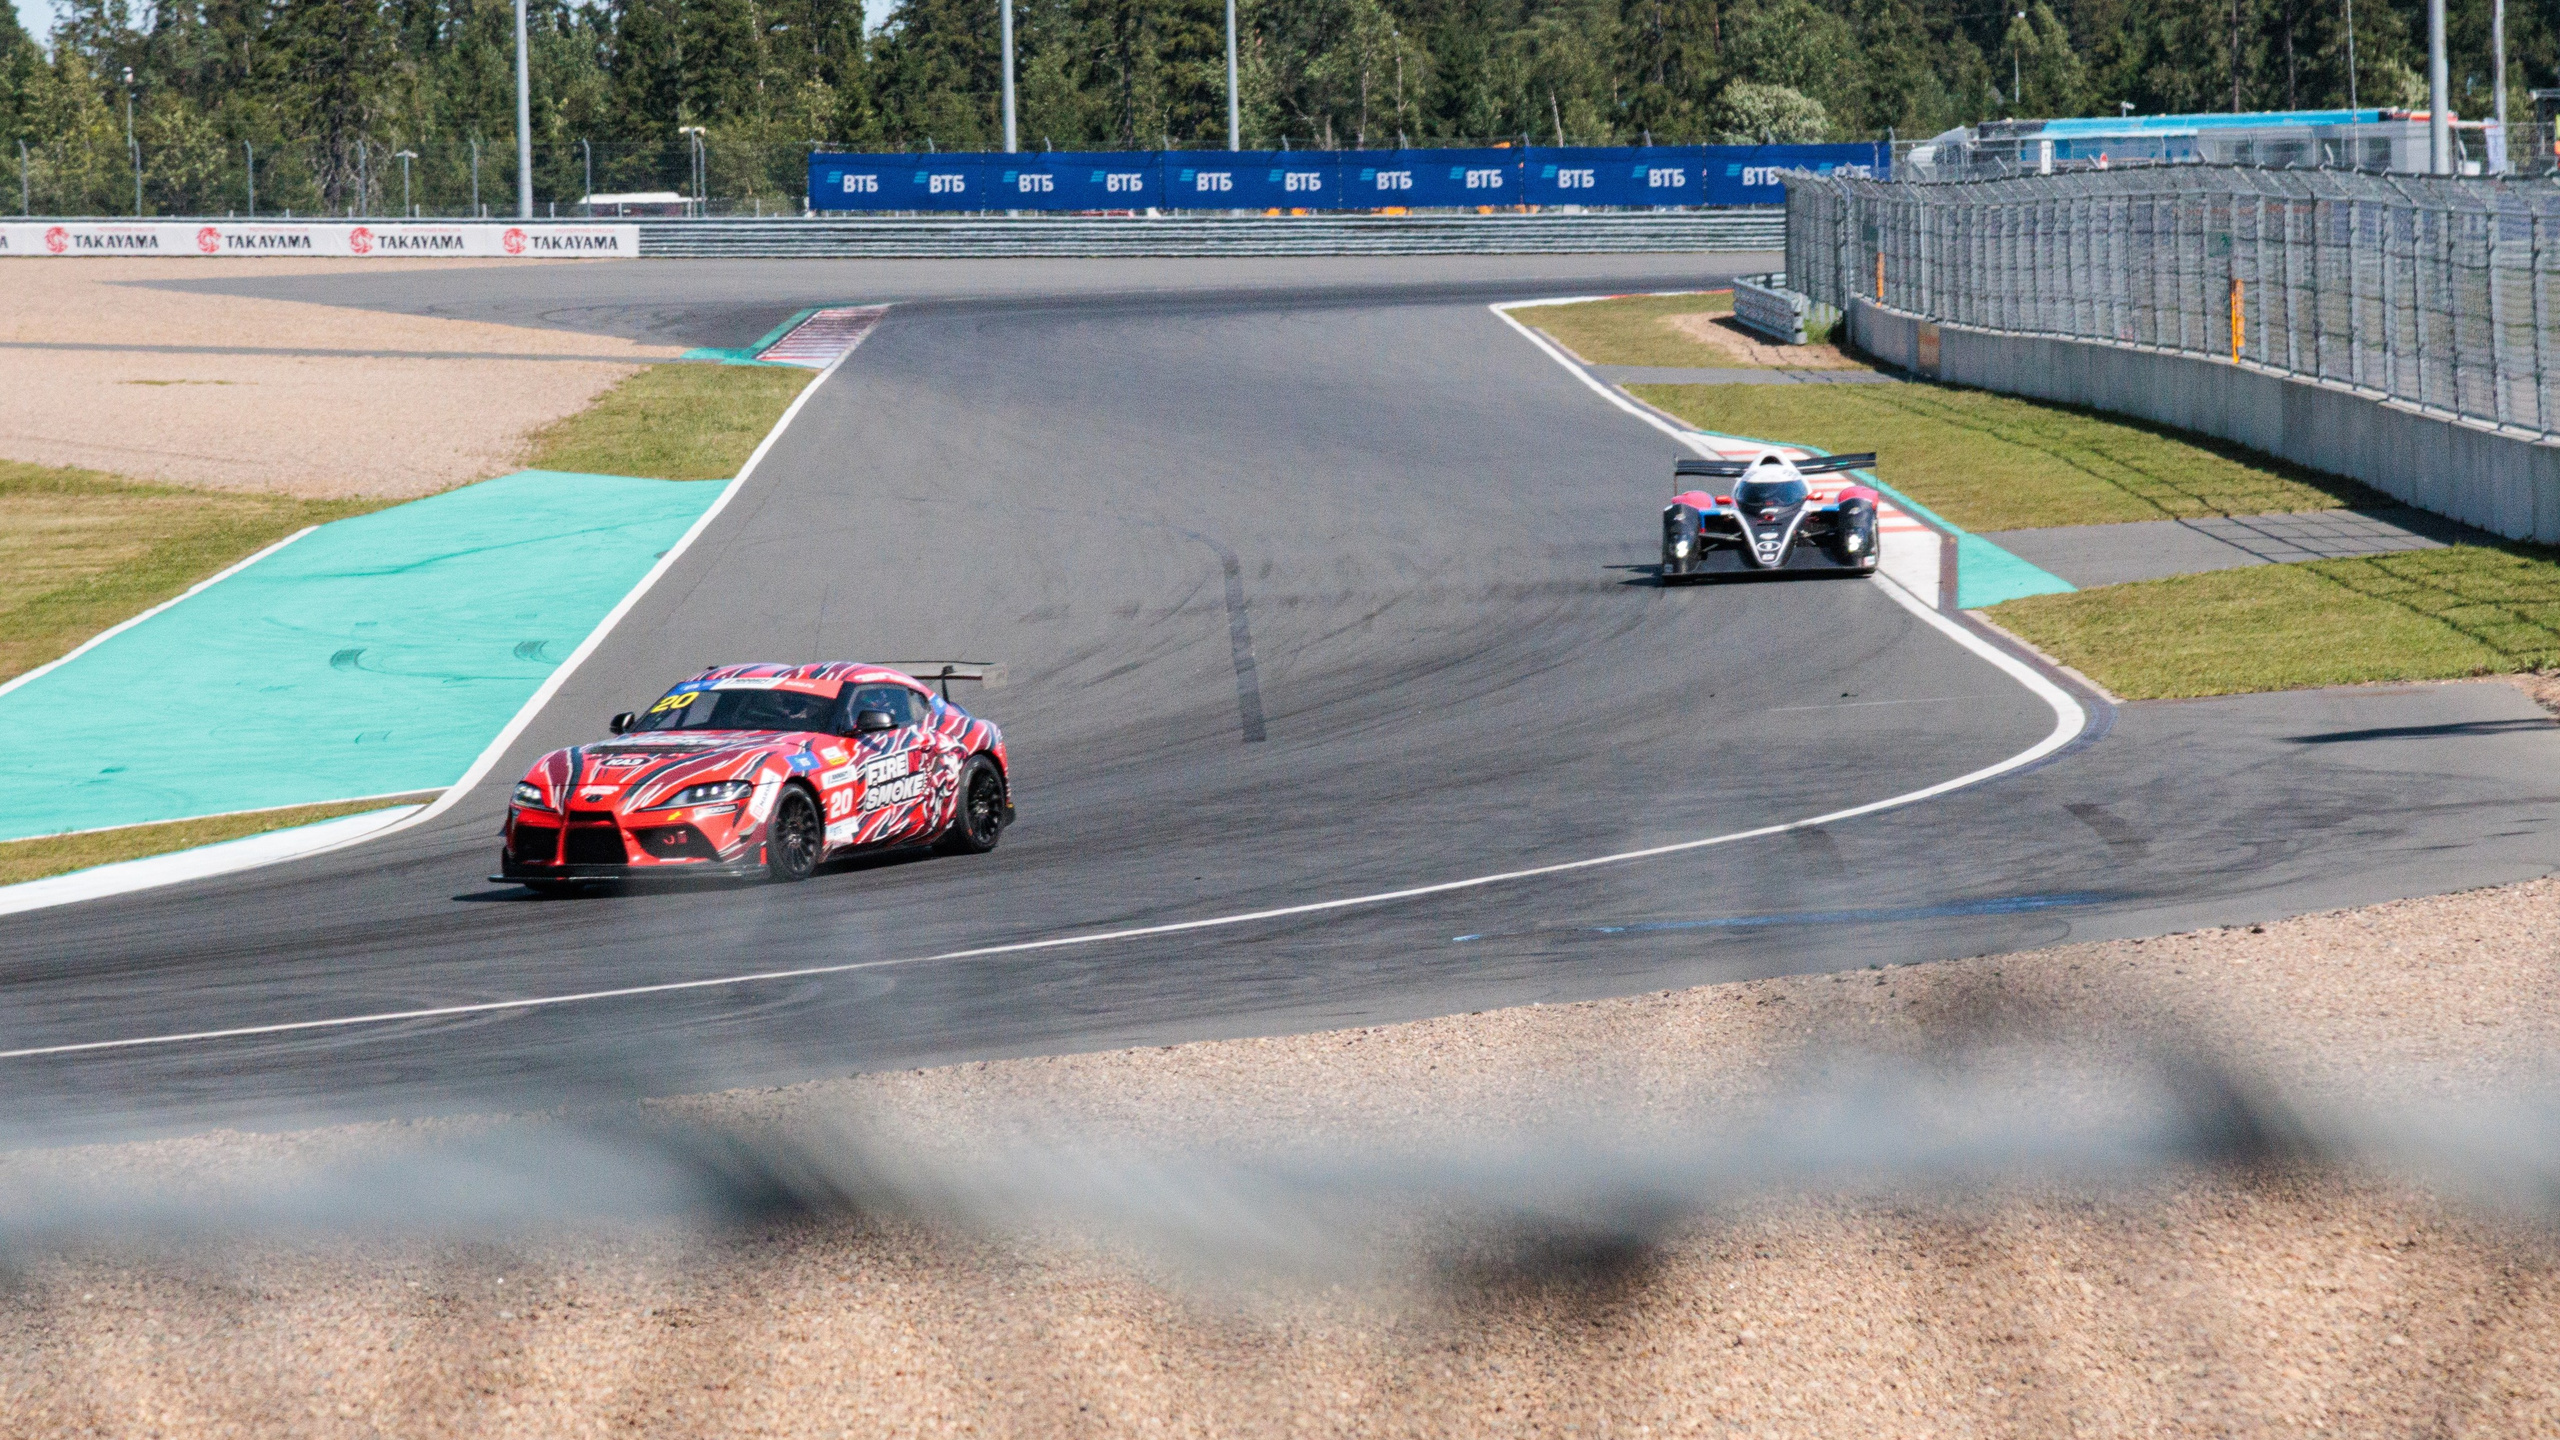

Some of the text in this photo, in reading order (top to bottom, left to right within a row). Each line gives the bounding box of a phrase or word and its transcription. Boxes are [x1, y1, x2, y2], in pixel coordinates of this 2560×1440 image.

[843, 174, 879, 193] ВТБ
[929, 174, 965, 193] ВТБ
[1018, 174, 1054, 193] ВТБ
[1106, 173, 1143, 192] ВТБ
[1197, 172, 1233, 191] ВТБ
[1285, 172, 1322, 192] ВТБ
[1376, 171, 1413, 190] ВТБ
[1466, 169, 1503, 188] ВТБ
[1558, 169, 1595, 188] ВТБ
[1649, 168, 1686, 187] ВТБ
[74, 234, 159, 248] TAKAYAMA
[226, 235, 312, 249] TAKAYAMA
[378, 235, 464, 249] TAKAYAMA
[532, 235, 618, 250] TAKAYAMA
[650, 691, 699, 713] 20
[867, 753, 908, 786] FIRE
[865, 773, 924, 811] SMOKE
[830, 788, 853, 819] 20
